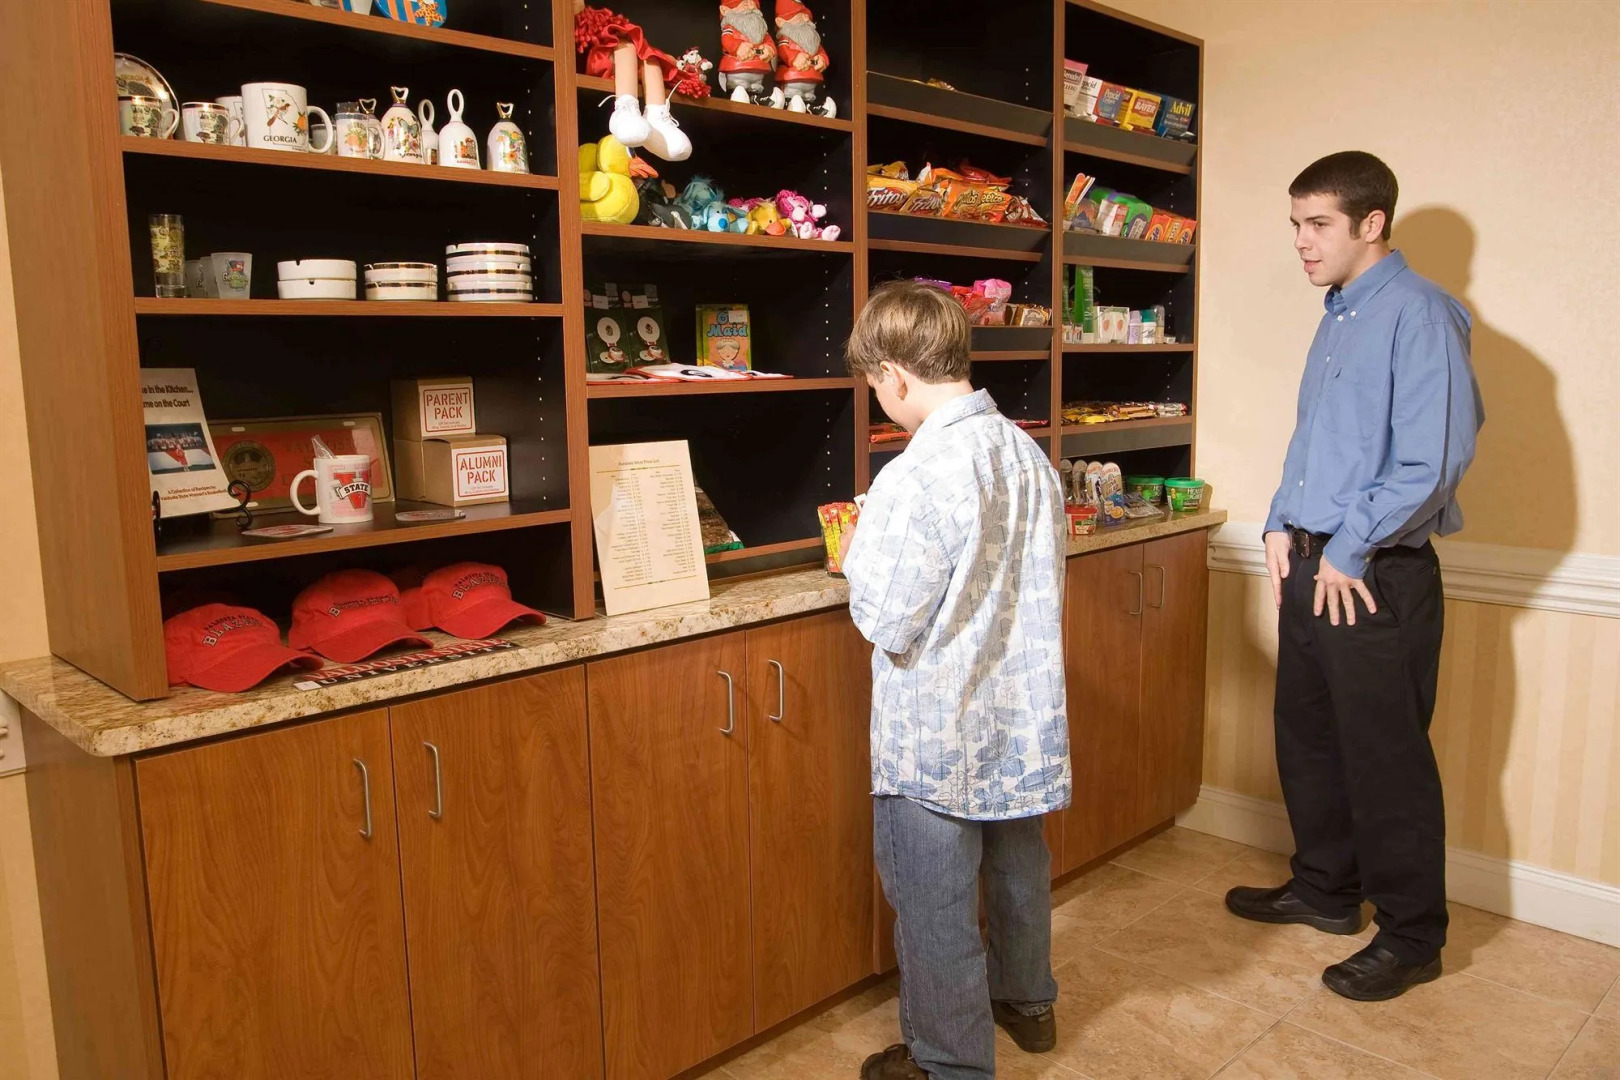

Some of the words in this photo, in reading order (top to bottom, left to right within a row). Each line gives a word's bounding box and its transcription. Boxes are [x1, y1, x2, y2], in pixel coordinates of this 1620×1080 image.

[1134, 101, 1157, 114] BAYER
[1170, 100, 1193, 117] Advil
[263, 134, 297, 143] GEORGIA
[867, 187, 907, 207] Fritos
[706, 323, 748, 337] Maid
[173, 398, 190, 407] Court
[426, 392, 468, 406] PARENT
[434, 406, 463, 420] PACK
[460, 455, 502, 471] ALUMNI
[467, 469, 496, 484] PACK
[344, 483, 369, 494] STATE
[304, 651, 430, 680] VALDOSTA
[318, 642, 514, 686] UNIVERSITY
